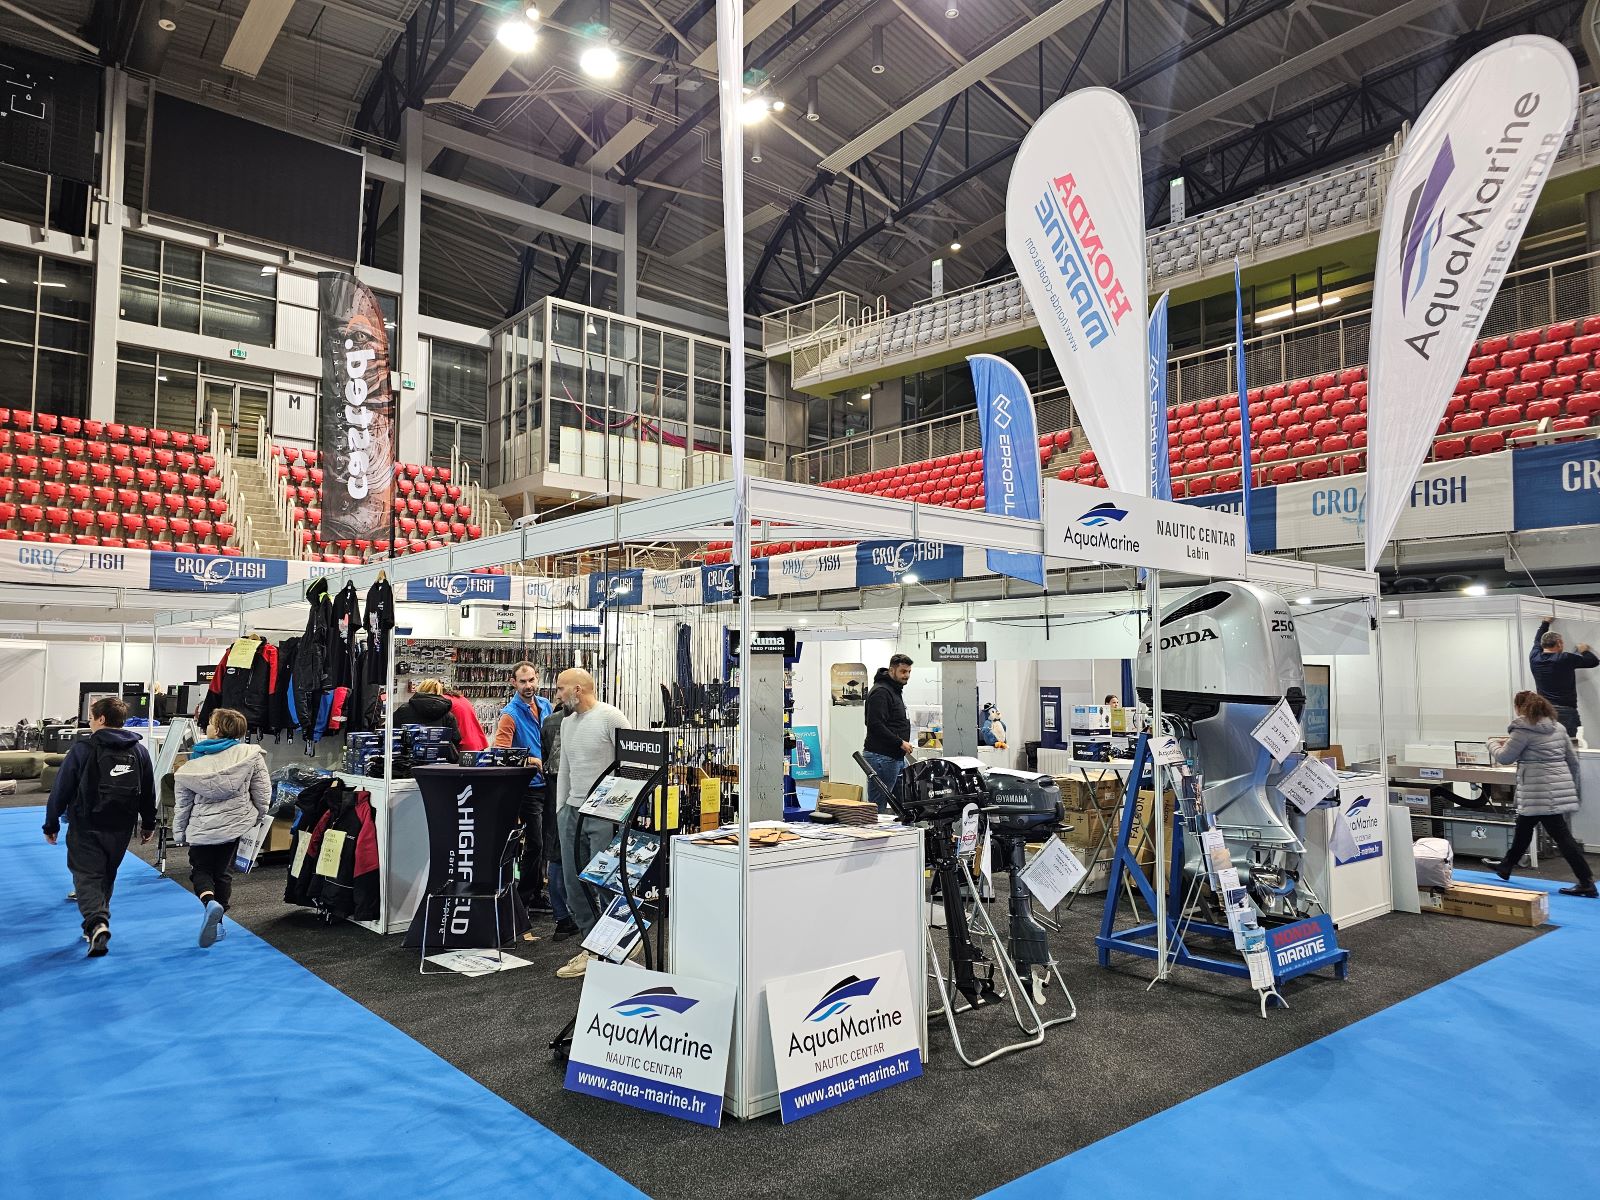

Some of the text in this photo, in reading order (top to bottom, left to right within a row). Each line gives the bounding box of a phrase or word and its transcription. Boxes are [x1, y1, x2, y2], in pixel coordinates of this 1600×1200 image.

[1404, 91, 1541, 361] AquaMarine
[1461, 132, 1562, 330] NAUTIC CENTAR
[288, 394, 301, 410] M
[1311, 475, 1467, 517] CRO FISH
[1063, 525, 1140, 553] AquaMarine
[1156, 519, 1236, 547] NAUTIC CENTAR
[18, 547, 124, 570] CRO FISH
[782, 553, 841, 576] CRO FISH
[872, 542, 944, 566] CRO FISH
[1186, 545, 1209, 561] Labin
[175, 557, 266, 579] CRO FISH
[707, 571, 723, 587] CRO
[425, 577, 495, 593] CRO FISH
[680, 574, 696, 589] FISH
[1271, 619, 1295, 633] 250
[750, 636, 785, 646] kuma
[938, 644, 979, 655] okuma
[625, 741, 661, 754] HIGHFIELD
[114, 764, 131, 773] NIKE
[972, 776, 978, 785] 5
[1002, 795, 1028, 804] YAMAHA
[448, 850, 456, 875] dare
[1273, 921, 1323, 947] HONDA
[1277, 938, 1327, 967] MARINE
[586, 1013, 714, 1062] AquaMarine
[788, 1008, 903, 1058] AquaMarine
[605, 1050, 684, 1080] NAUTIC CENTAR
[814, 1042, 886, 1073] NAUTIC CENTAR
[577, 1070, 707, 1115] www.aqua-marine.hr
[793, 1058, 911, 1110] www.aqua-marine.hr
